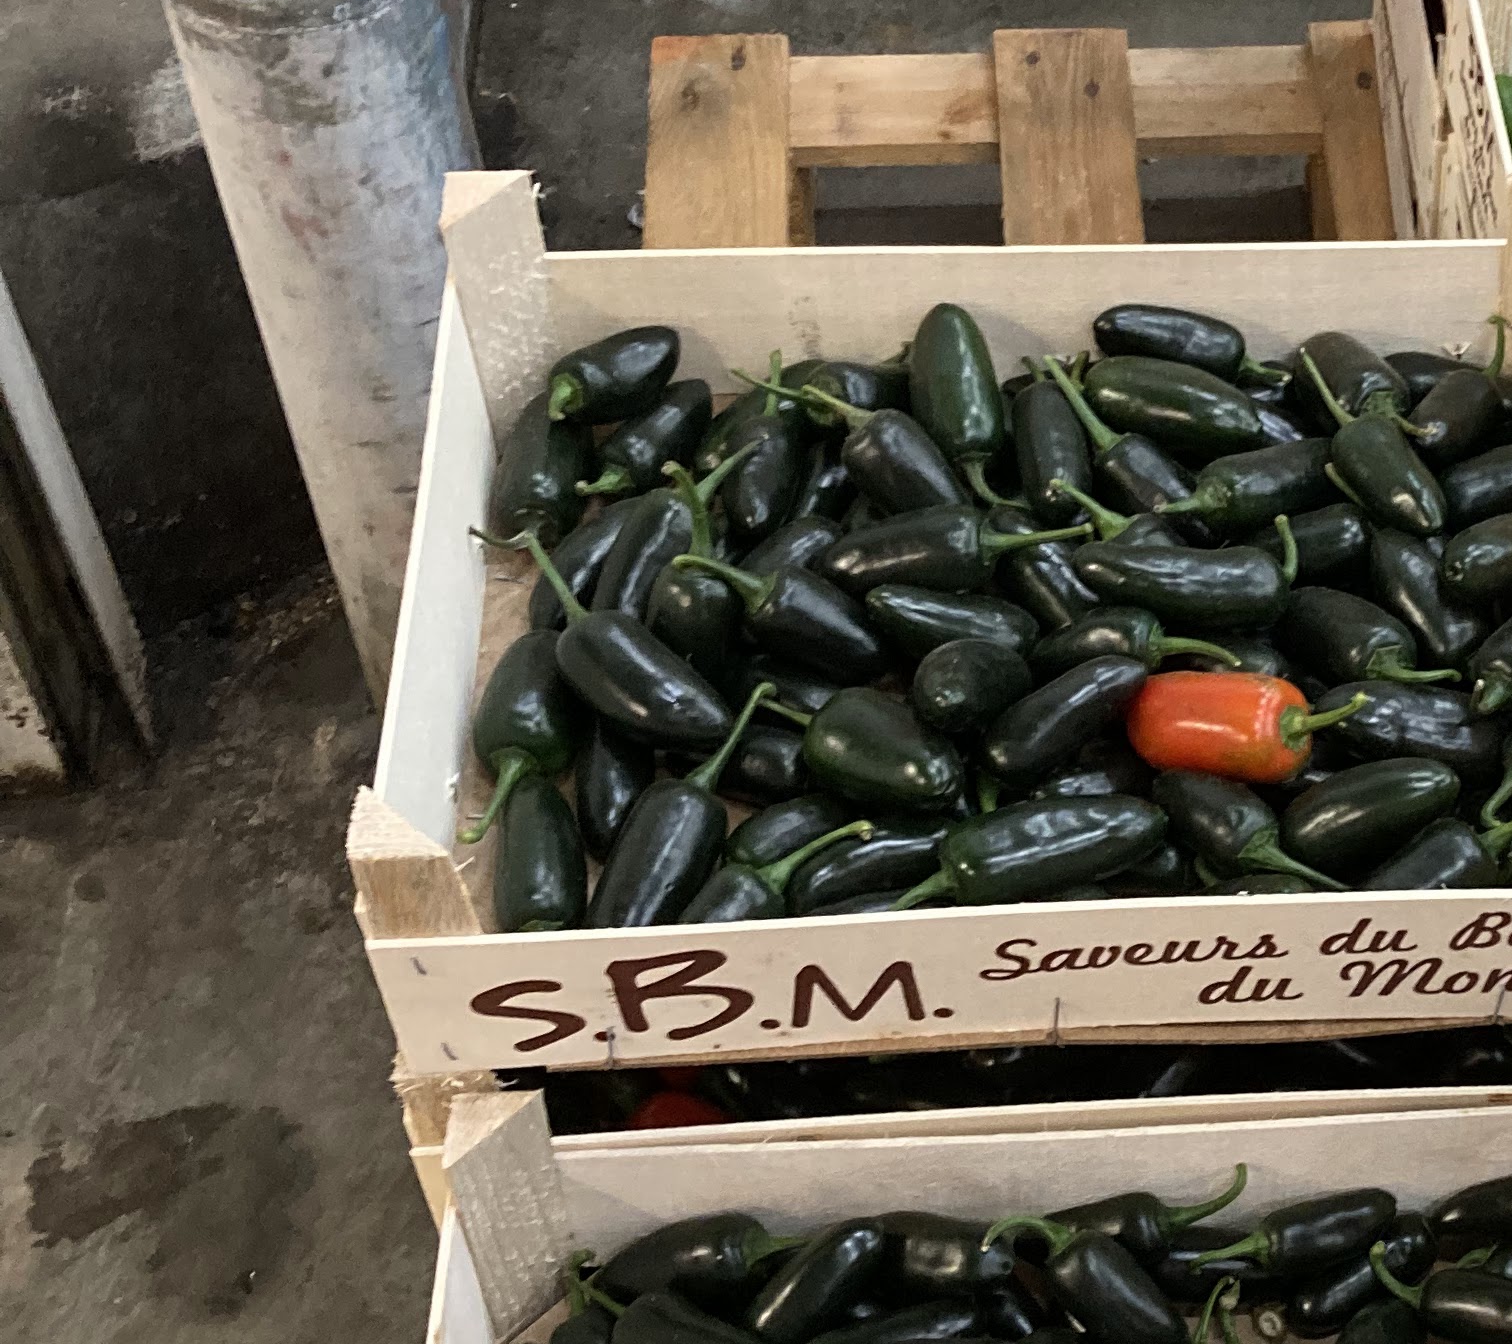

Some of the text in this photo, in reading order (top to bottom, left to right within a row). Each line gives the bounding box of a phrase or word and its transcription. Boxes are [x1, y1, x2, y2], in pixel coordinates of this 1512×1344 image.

[979, 934, 1289, 983] Saveurs
[1318, 916, 1417, 960] du
[469, 947, 952, 1052] S.B.M.
[1199, 963, 1302, 1006] du
